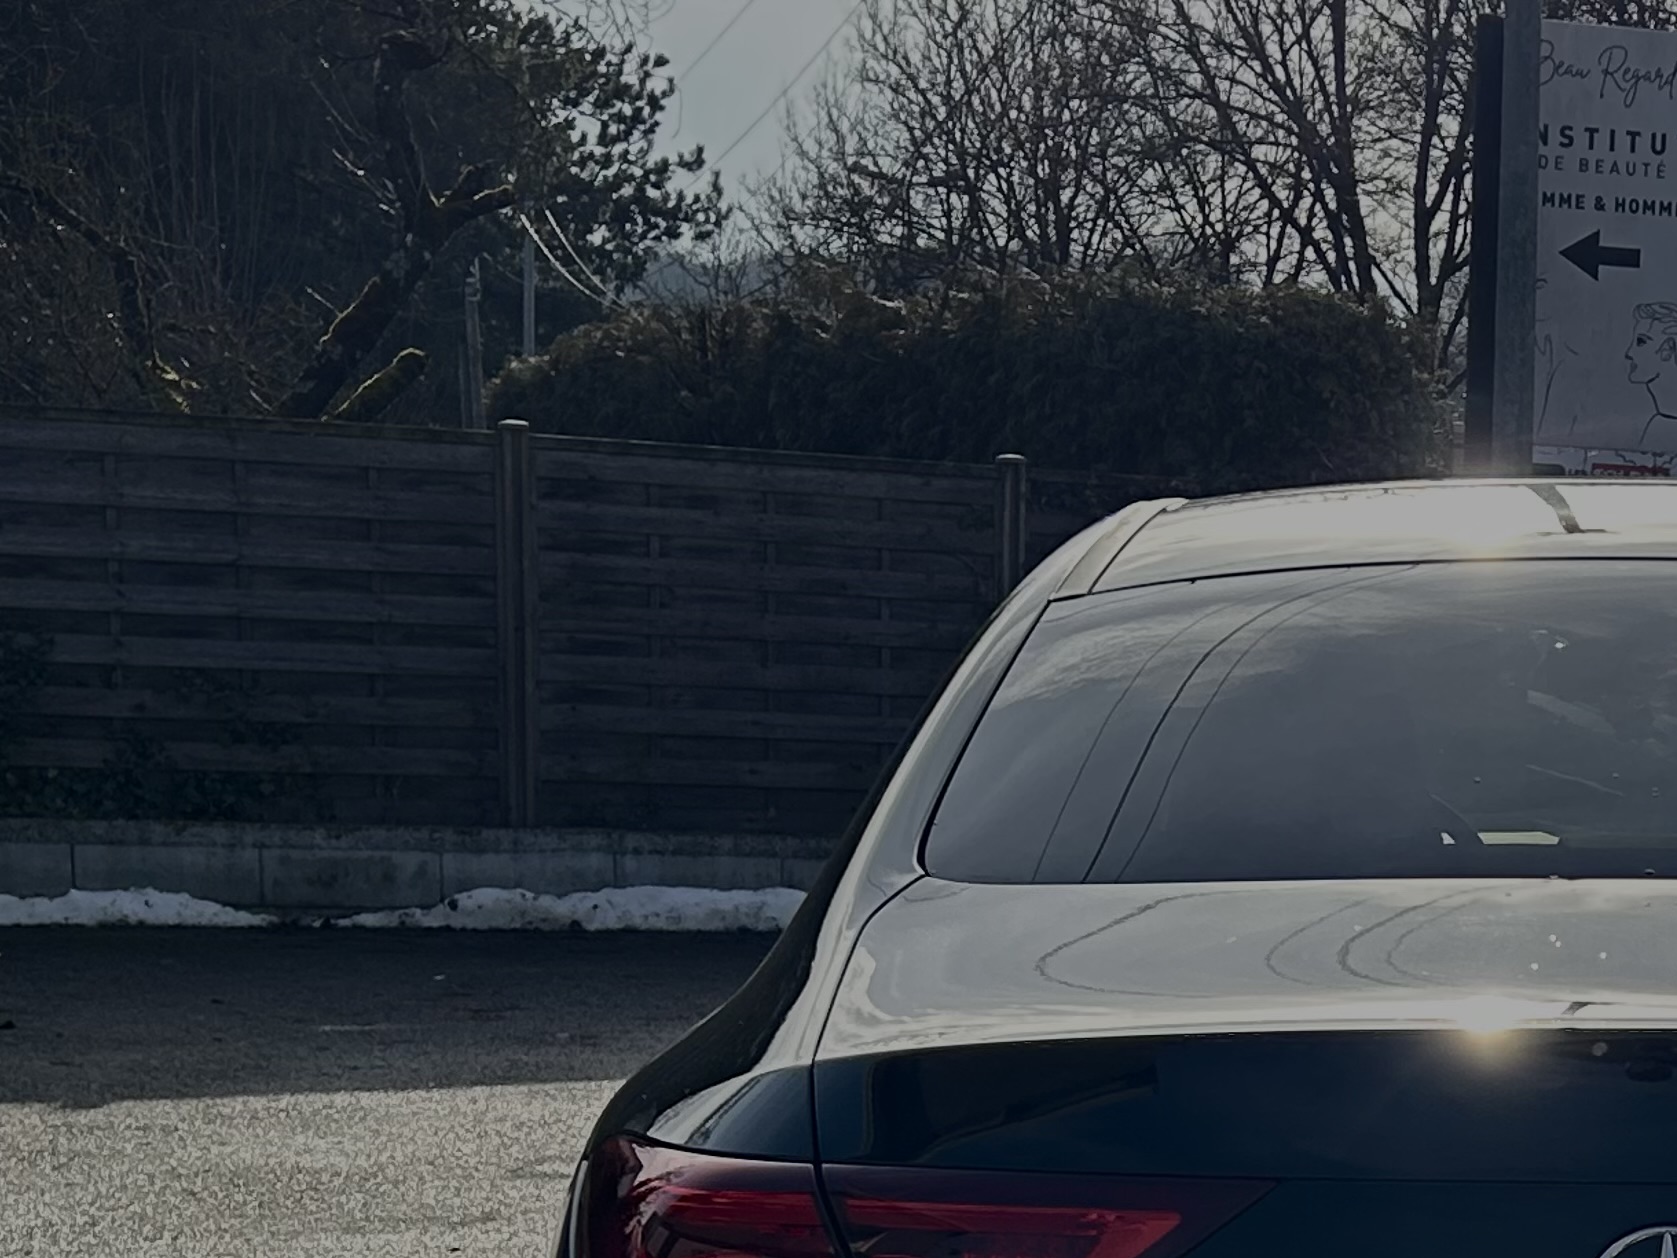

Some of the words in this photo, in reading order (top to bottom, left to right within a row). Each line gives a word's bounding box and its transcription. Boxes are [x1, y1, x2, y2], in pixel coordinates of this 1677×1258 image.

[1538, 153, 1565, 172] DE
[1577, 156, 1667, 180] BEAUTÉ
[1593, 195, 1607, 213] &
